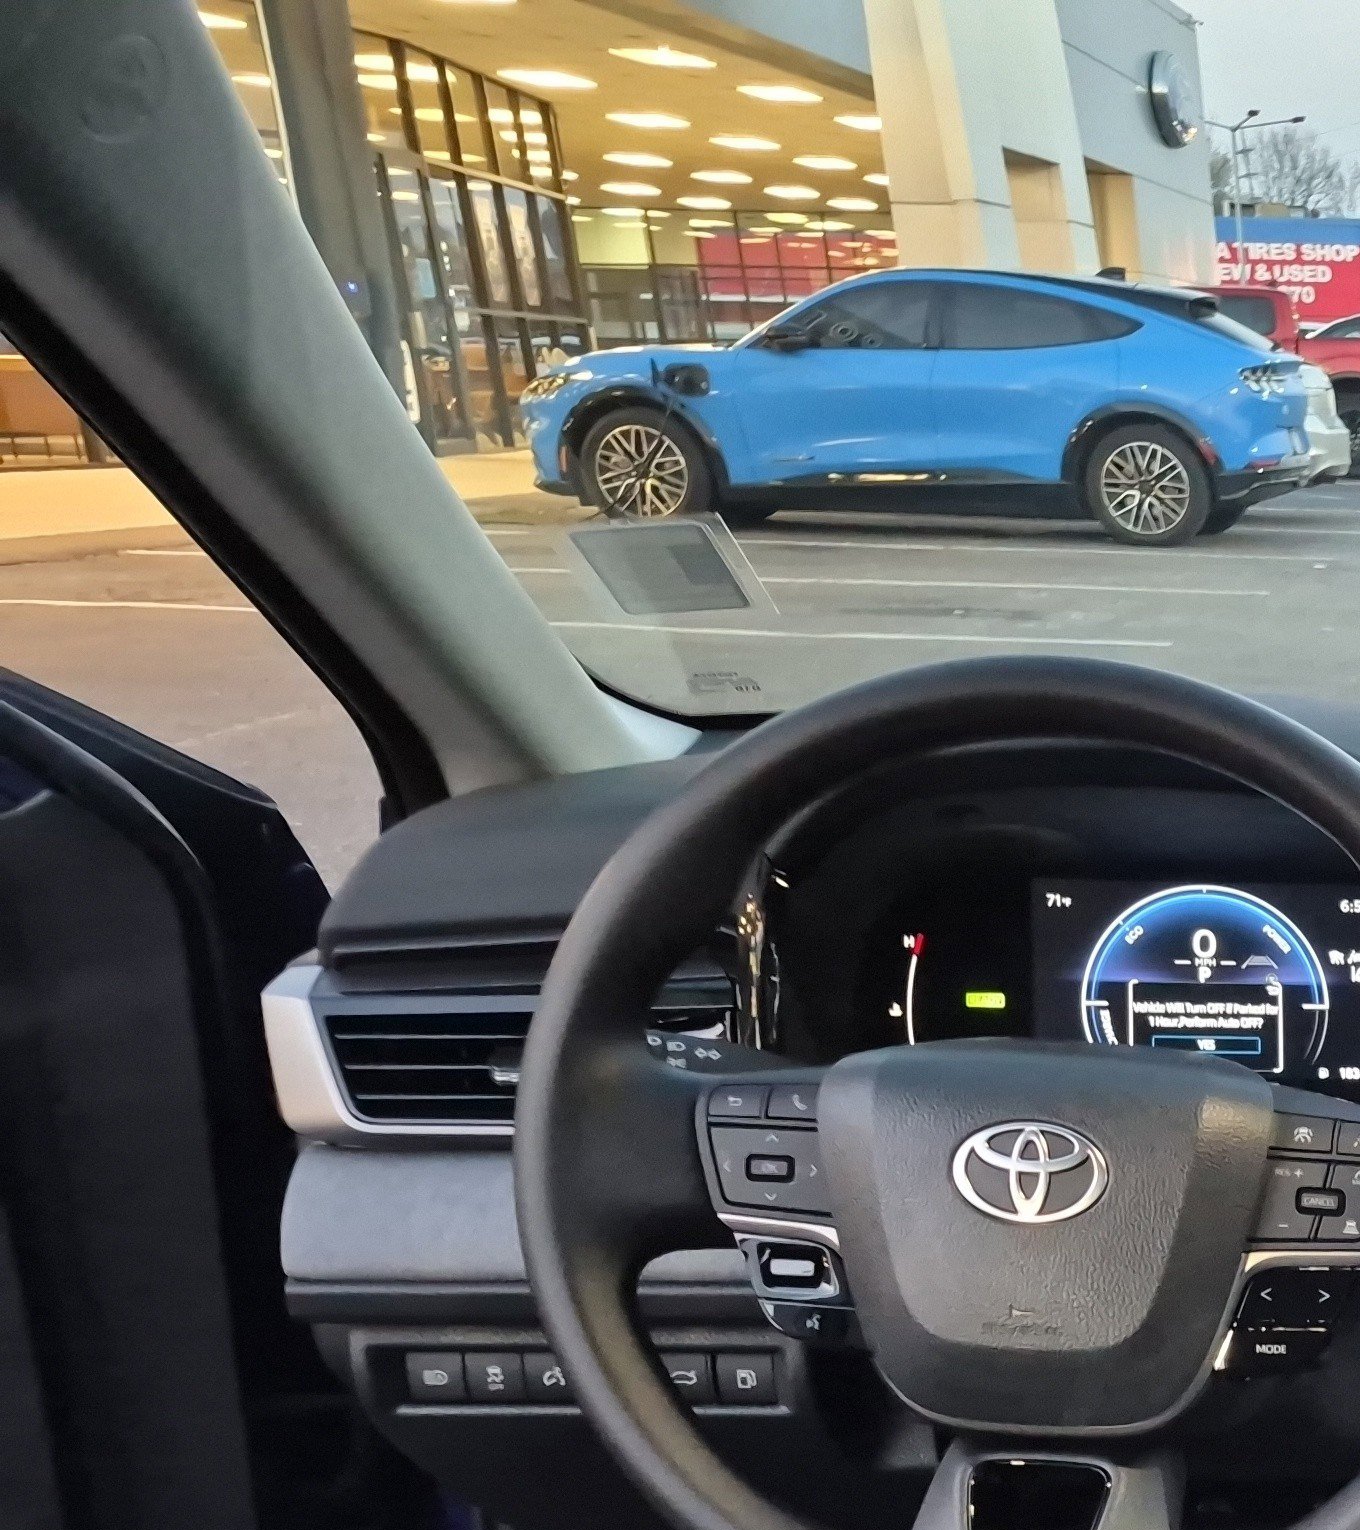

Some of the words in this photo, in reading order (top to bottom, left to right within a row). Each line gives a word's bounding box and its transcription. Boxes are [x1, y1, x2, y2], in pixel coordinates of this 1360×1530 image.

[1231, 242, 1298, 261] TIRES
[1300, 243, 1360, 263] SHOP
[1254, 263, 1273, 282] &
[1272, 263, 1334, 283] USED
[1194, 957, 1217, 967] MPH
[1199, 966, 1213, 984] P
[1196, 1038, 1217, 1051] YES
[1255, 1344, 1287, 1355] MODE
